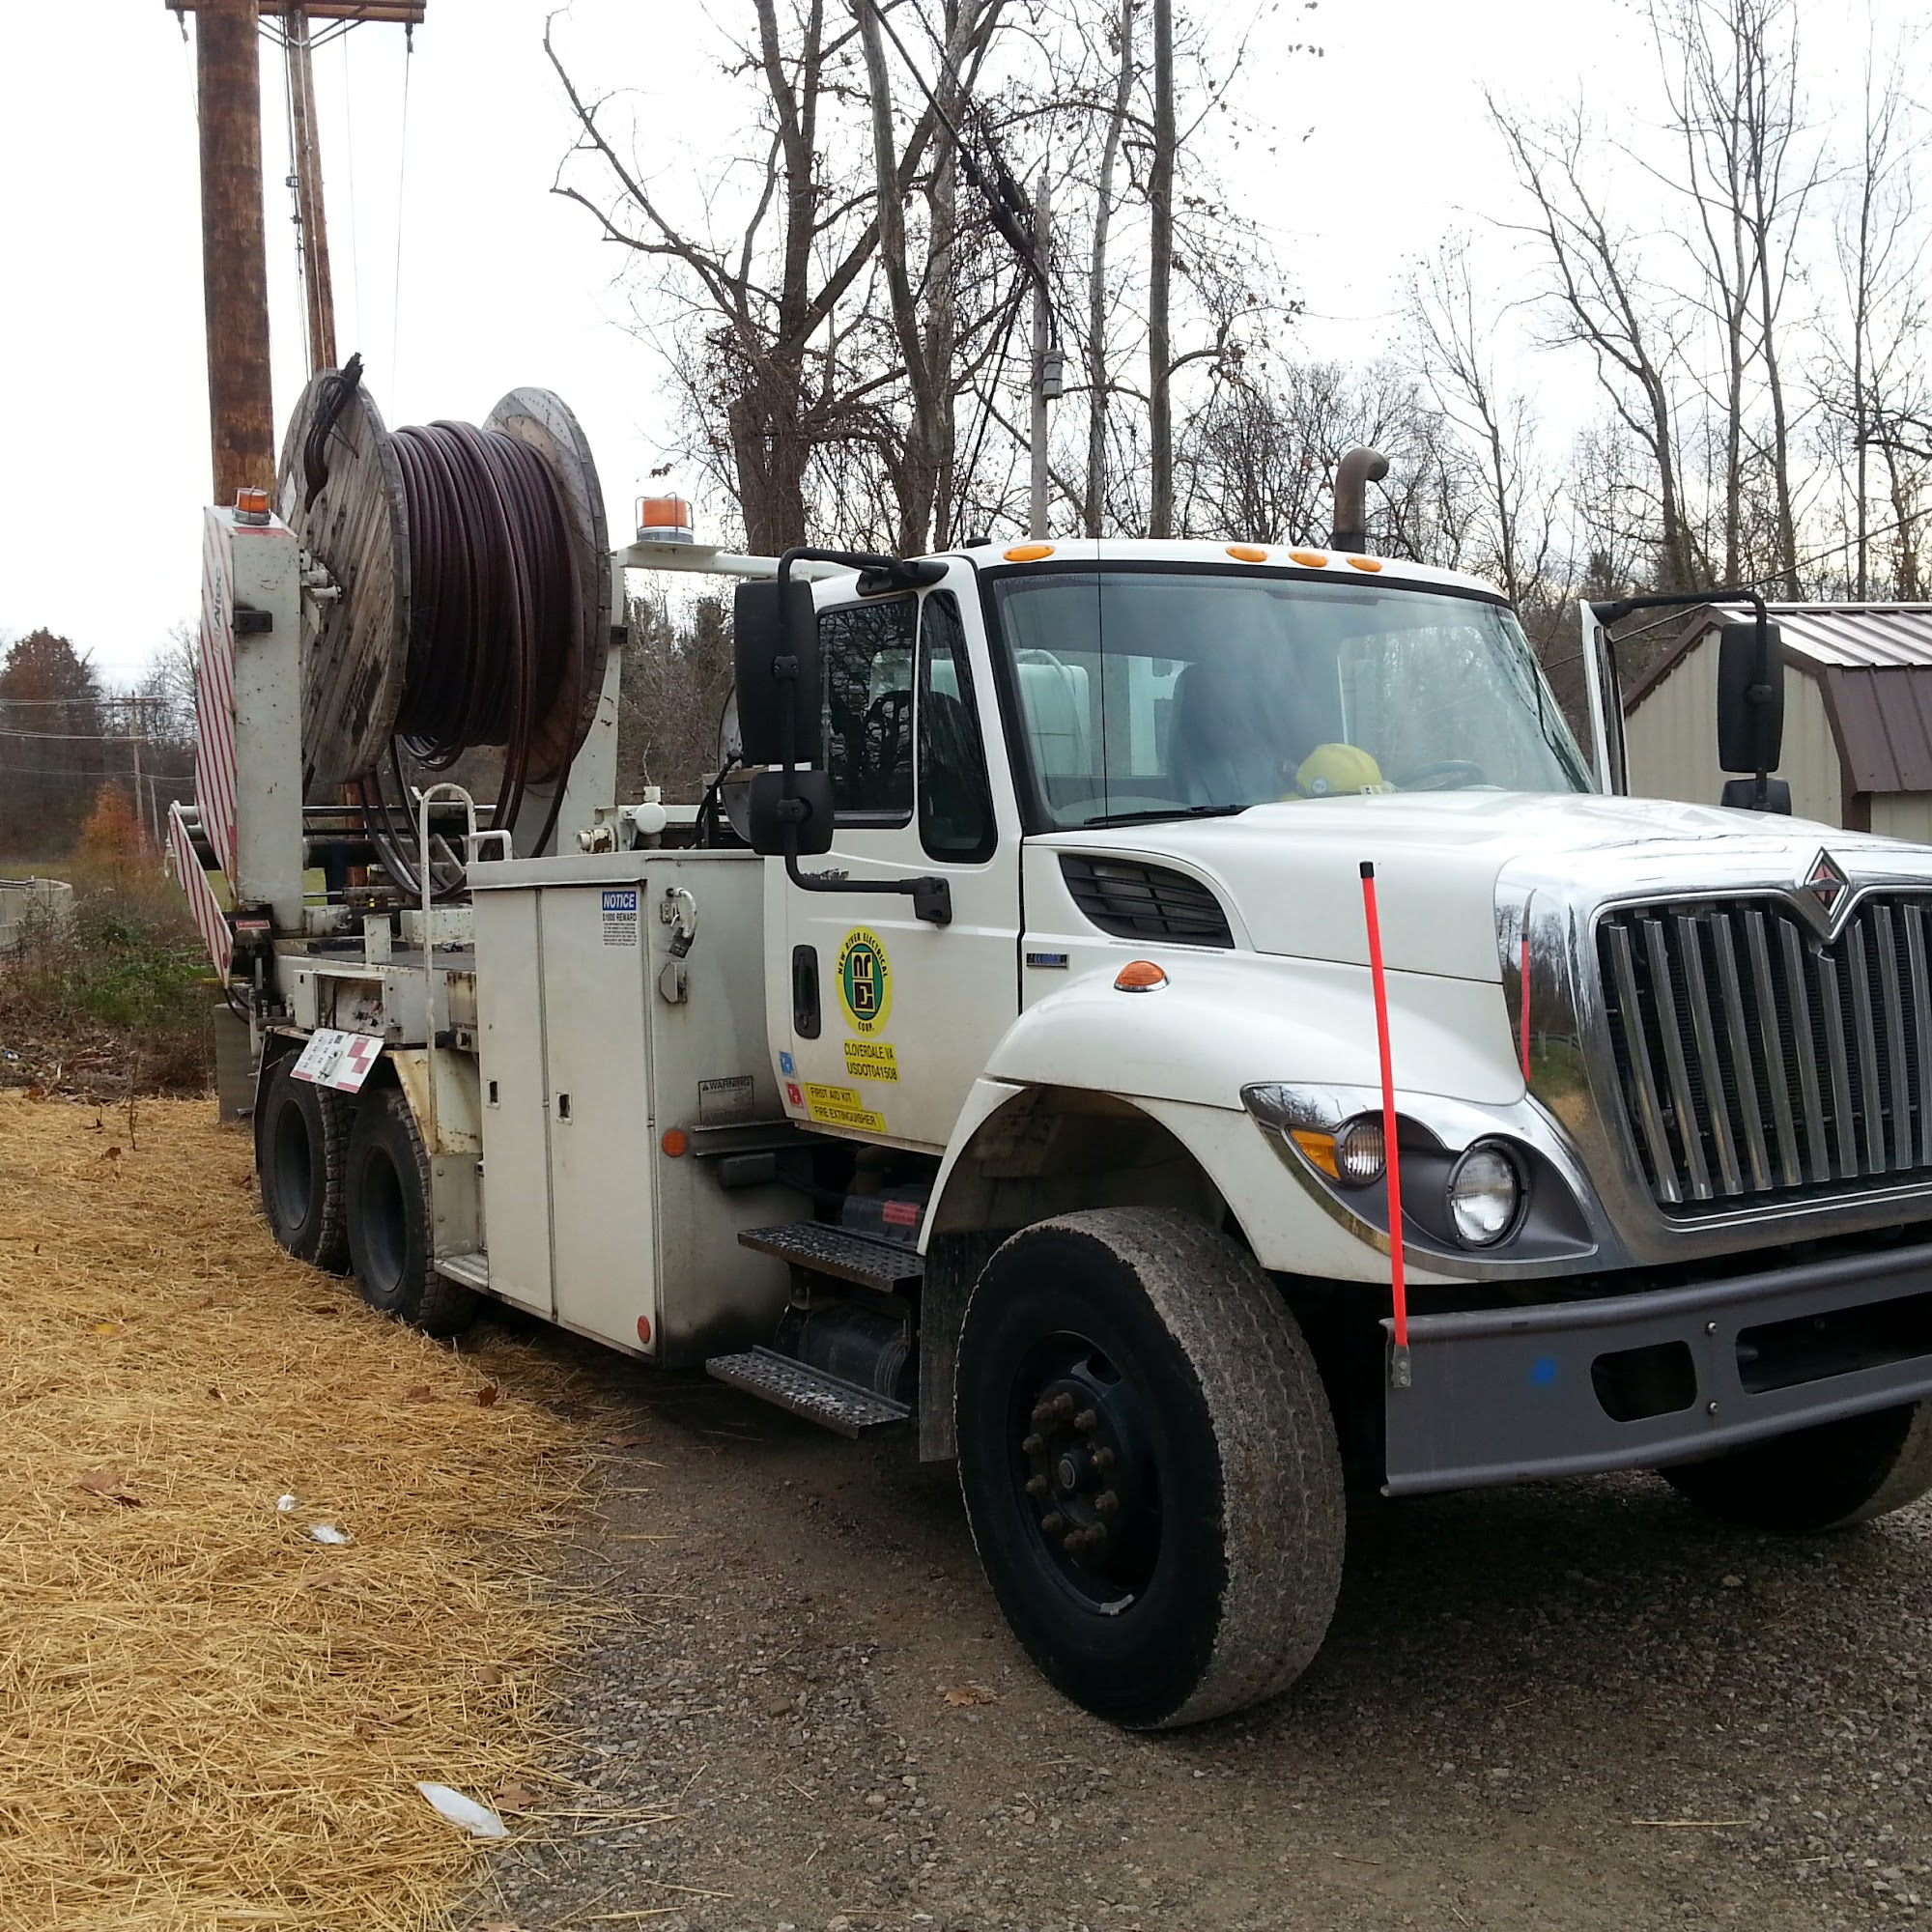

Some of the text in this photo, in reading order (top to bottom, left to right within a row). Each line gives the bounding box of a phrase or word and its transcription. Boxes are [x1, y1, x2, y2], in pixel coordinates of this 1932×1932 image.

[603, 894, 635, 909] NOTICE
[616, 913, 637, 922] REWARD
[838, 932, 888, 978] NEW RIVER ELECTRICAL
[858, 1022, 874, 1032] CORP.
[885, 1047, 895, 1061] VA
[709, 1078, 750, 1090] WARNING
[810, 1087, 827, 1098] FIRST
[829, 1090, 840, 1100] AID
[841, 1092, 852, 1102] KIT
[814, 1106, 876, 1125] FIRE EXTINGUISHER
